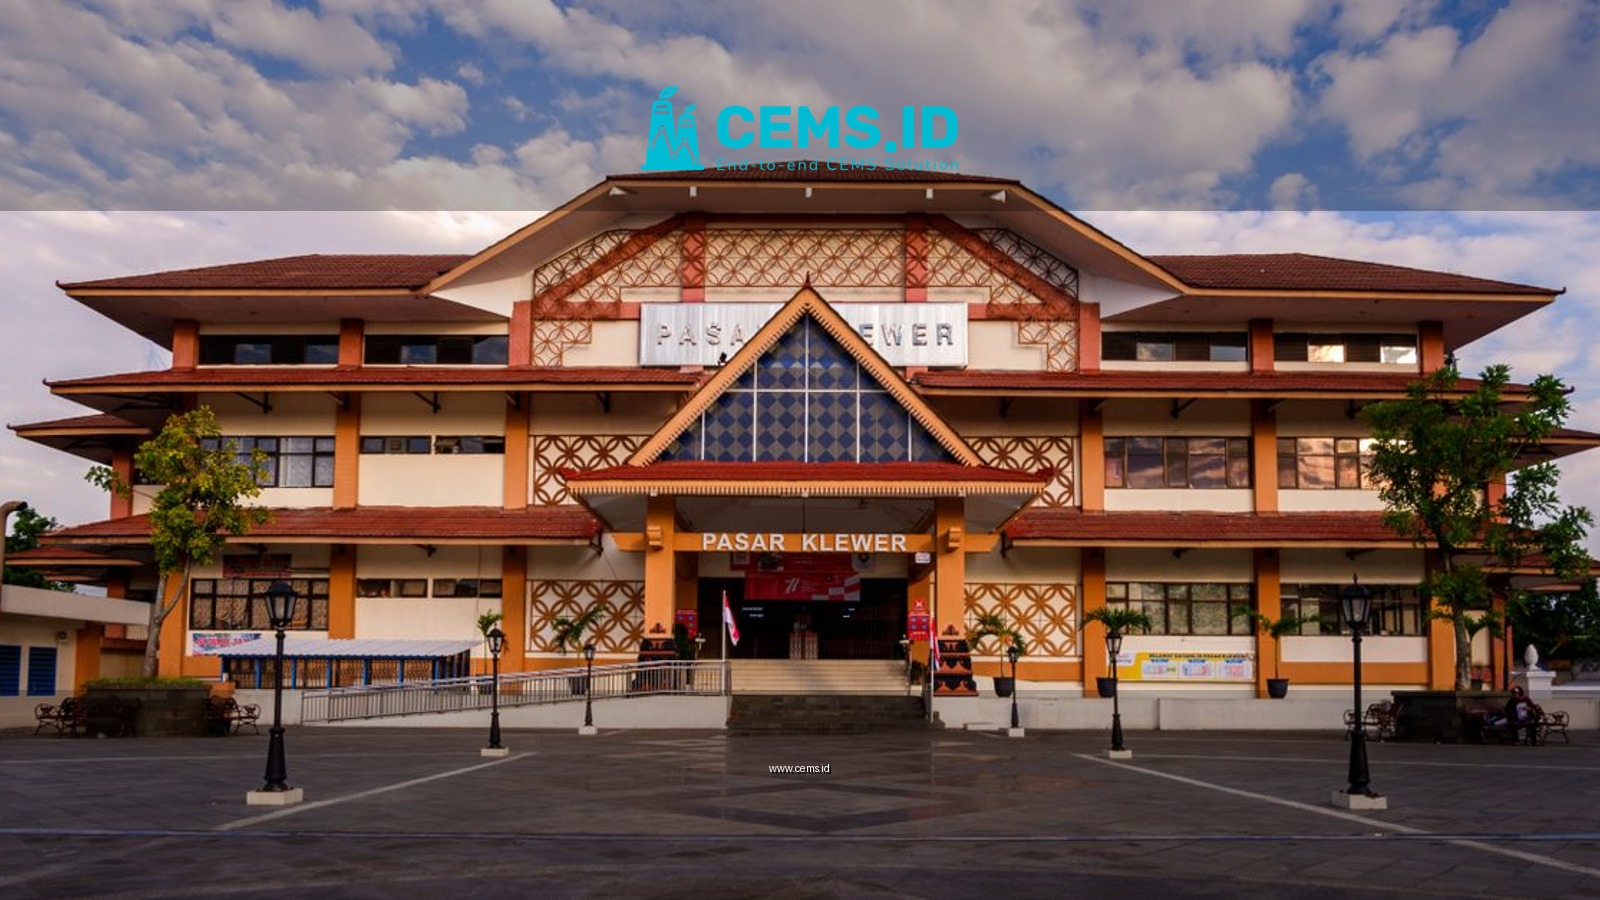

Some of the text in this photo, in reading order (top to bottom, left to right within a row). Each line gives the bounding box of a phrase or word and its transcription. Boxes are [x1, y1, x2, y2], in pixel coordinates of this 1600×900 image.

[657, 322, 954, 346] PASA EWER
[702, 532, 907, 551] PASAR KLEWER
